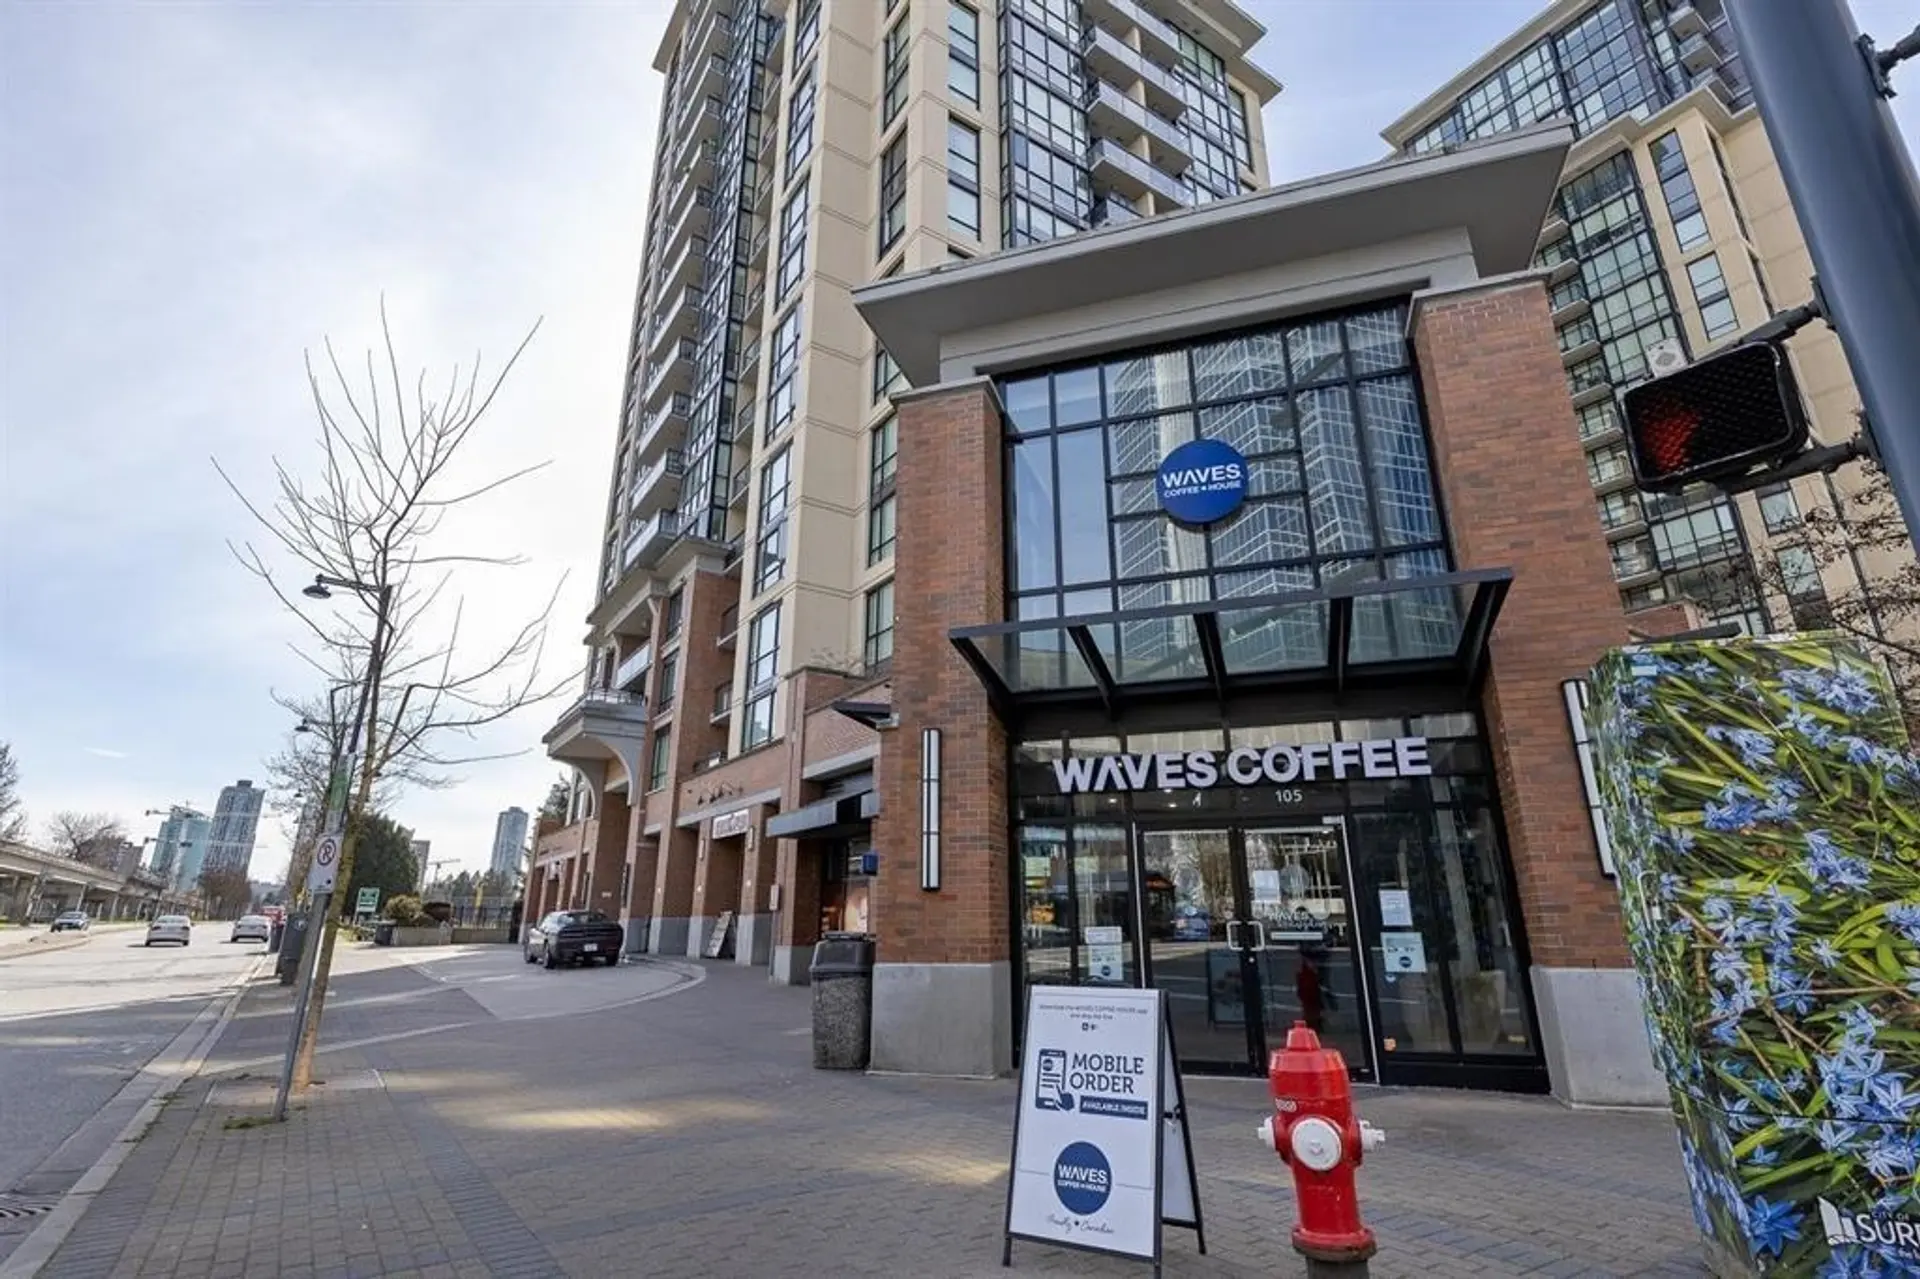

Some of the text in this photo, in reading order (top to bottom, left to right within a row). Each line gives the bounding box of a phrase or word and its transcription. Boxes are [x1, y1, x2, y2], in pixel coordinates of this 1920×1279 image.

[1162, 463, 1241, 488] WAVES
[1164, 480, 1242, 498] COFFEE HOUSE
[1052, 737, 1432, 793] WAVES COFFEE
[1275, 789, 1303, 803] 105
[1072, 1052, 1144, 1075] MOBILE
[1069, 1072, 1134, 1094] ORDER
[1058, 1163, 1107, 1184] WAVES
